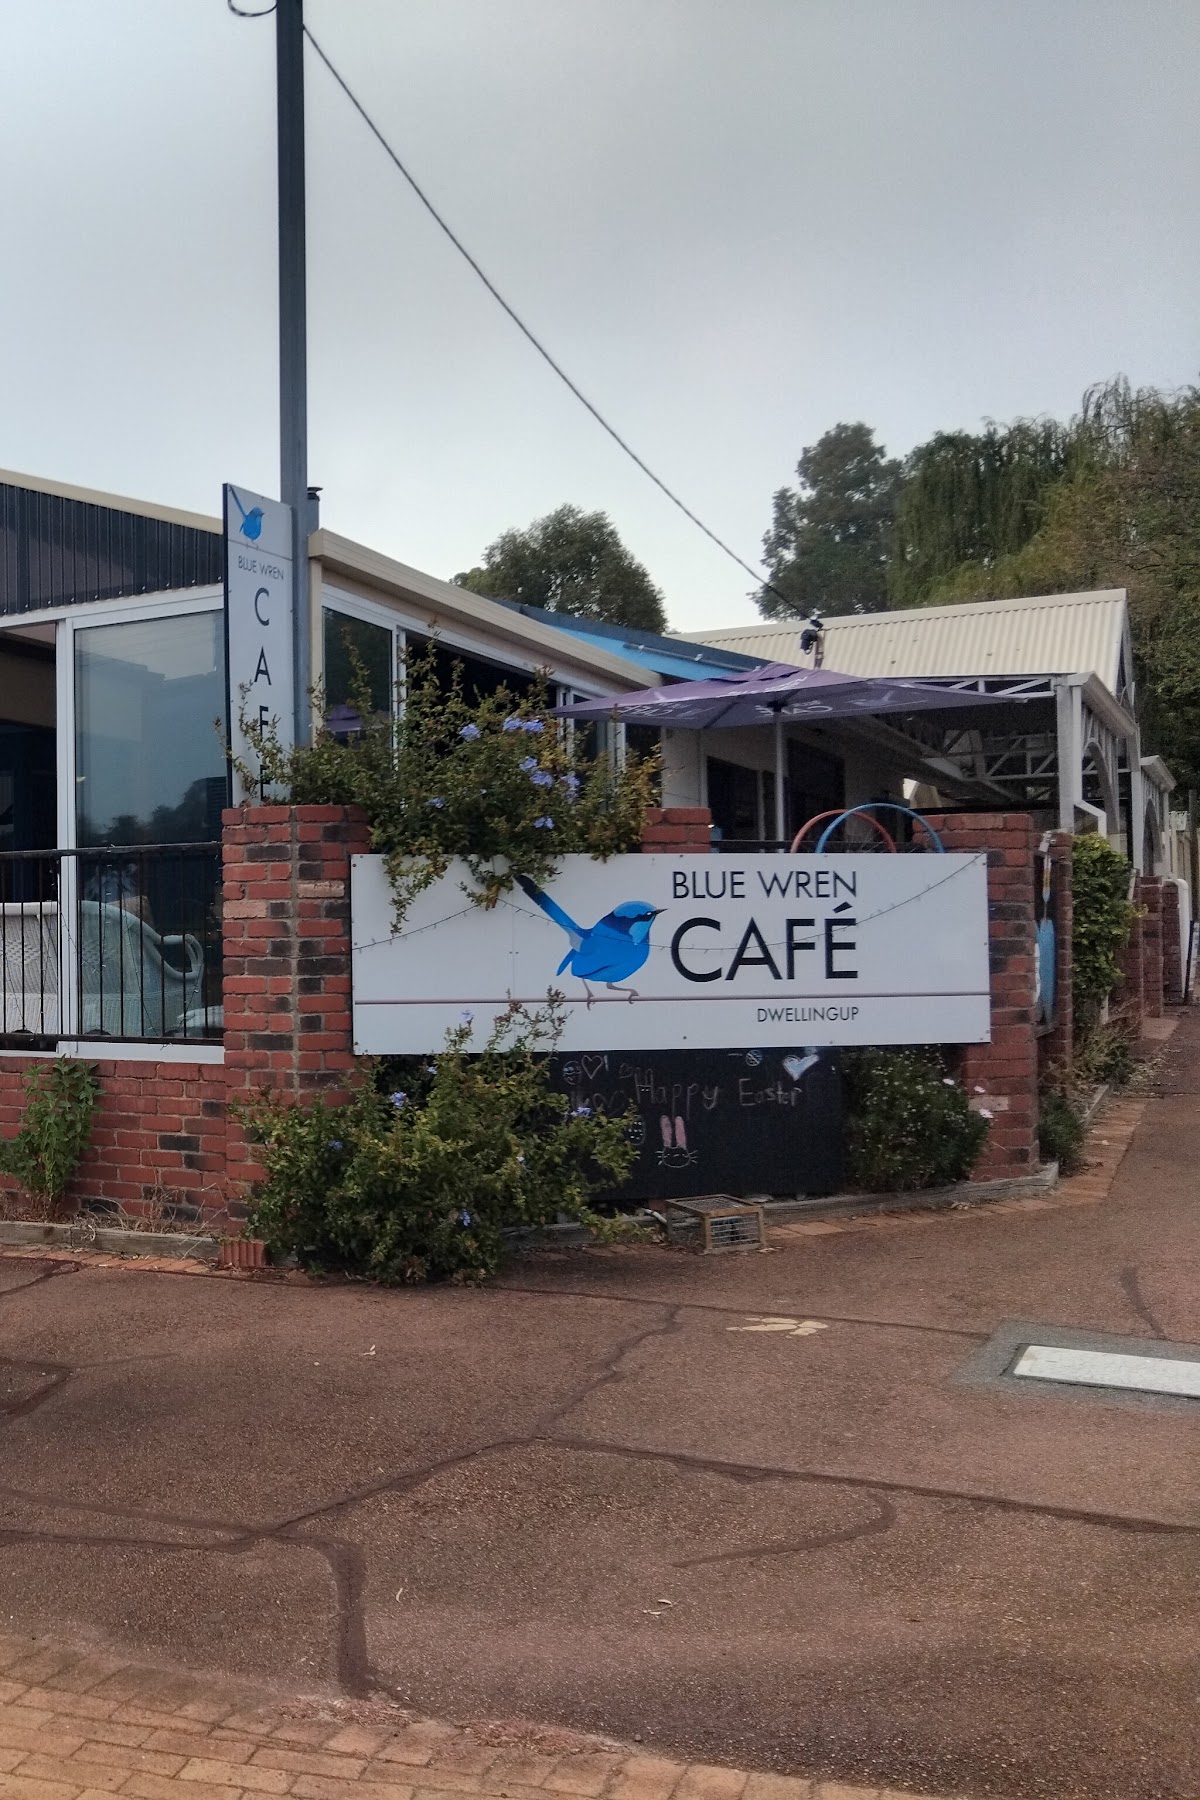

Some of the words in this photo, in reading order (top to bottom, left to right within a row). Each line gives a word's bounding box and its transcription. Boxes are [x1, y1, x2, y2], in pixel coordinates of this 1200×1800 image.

[238, 555, 257, 574] BLUE
[259, 562, 284, 580] WREN
[672, 871, 746, 899] BLUE
[757, 870, 857, 898] WREN
[670, 901, 859, 983] CAFÉ
[756, 1006, 860, 1023] DWELLINGUP
[634, 1068, 720, 1119] Happy
[739, 1078, 803, 1106] Easter
